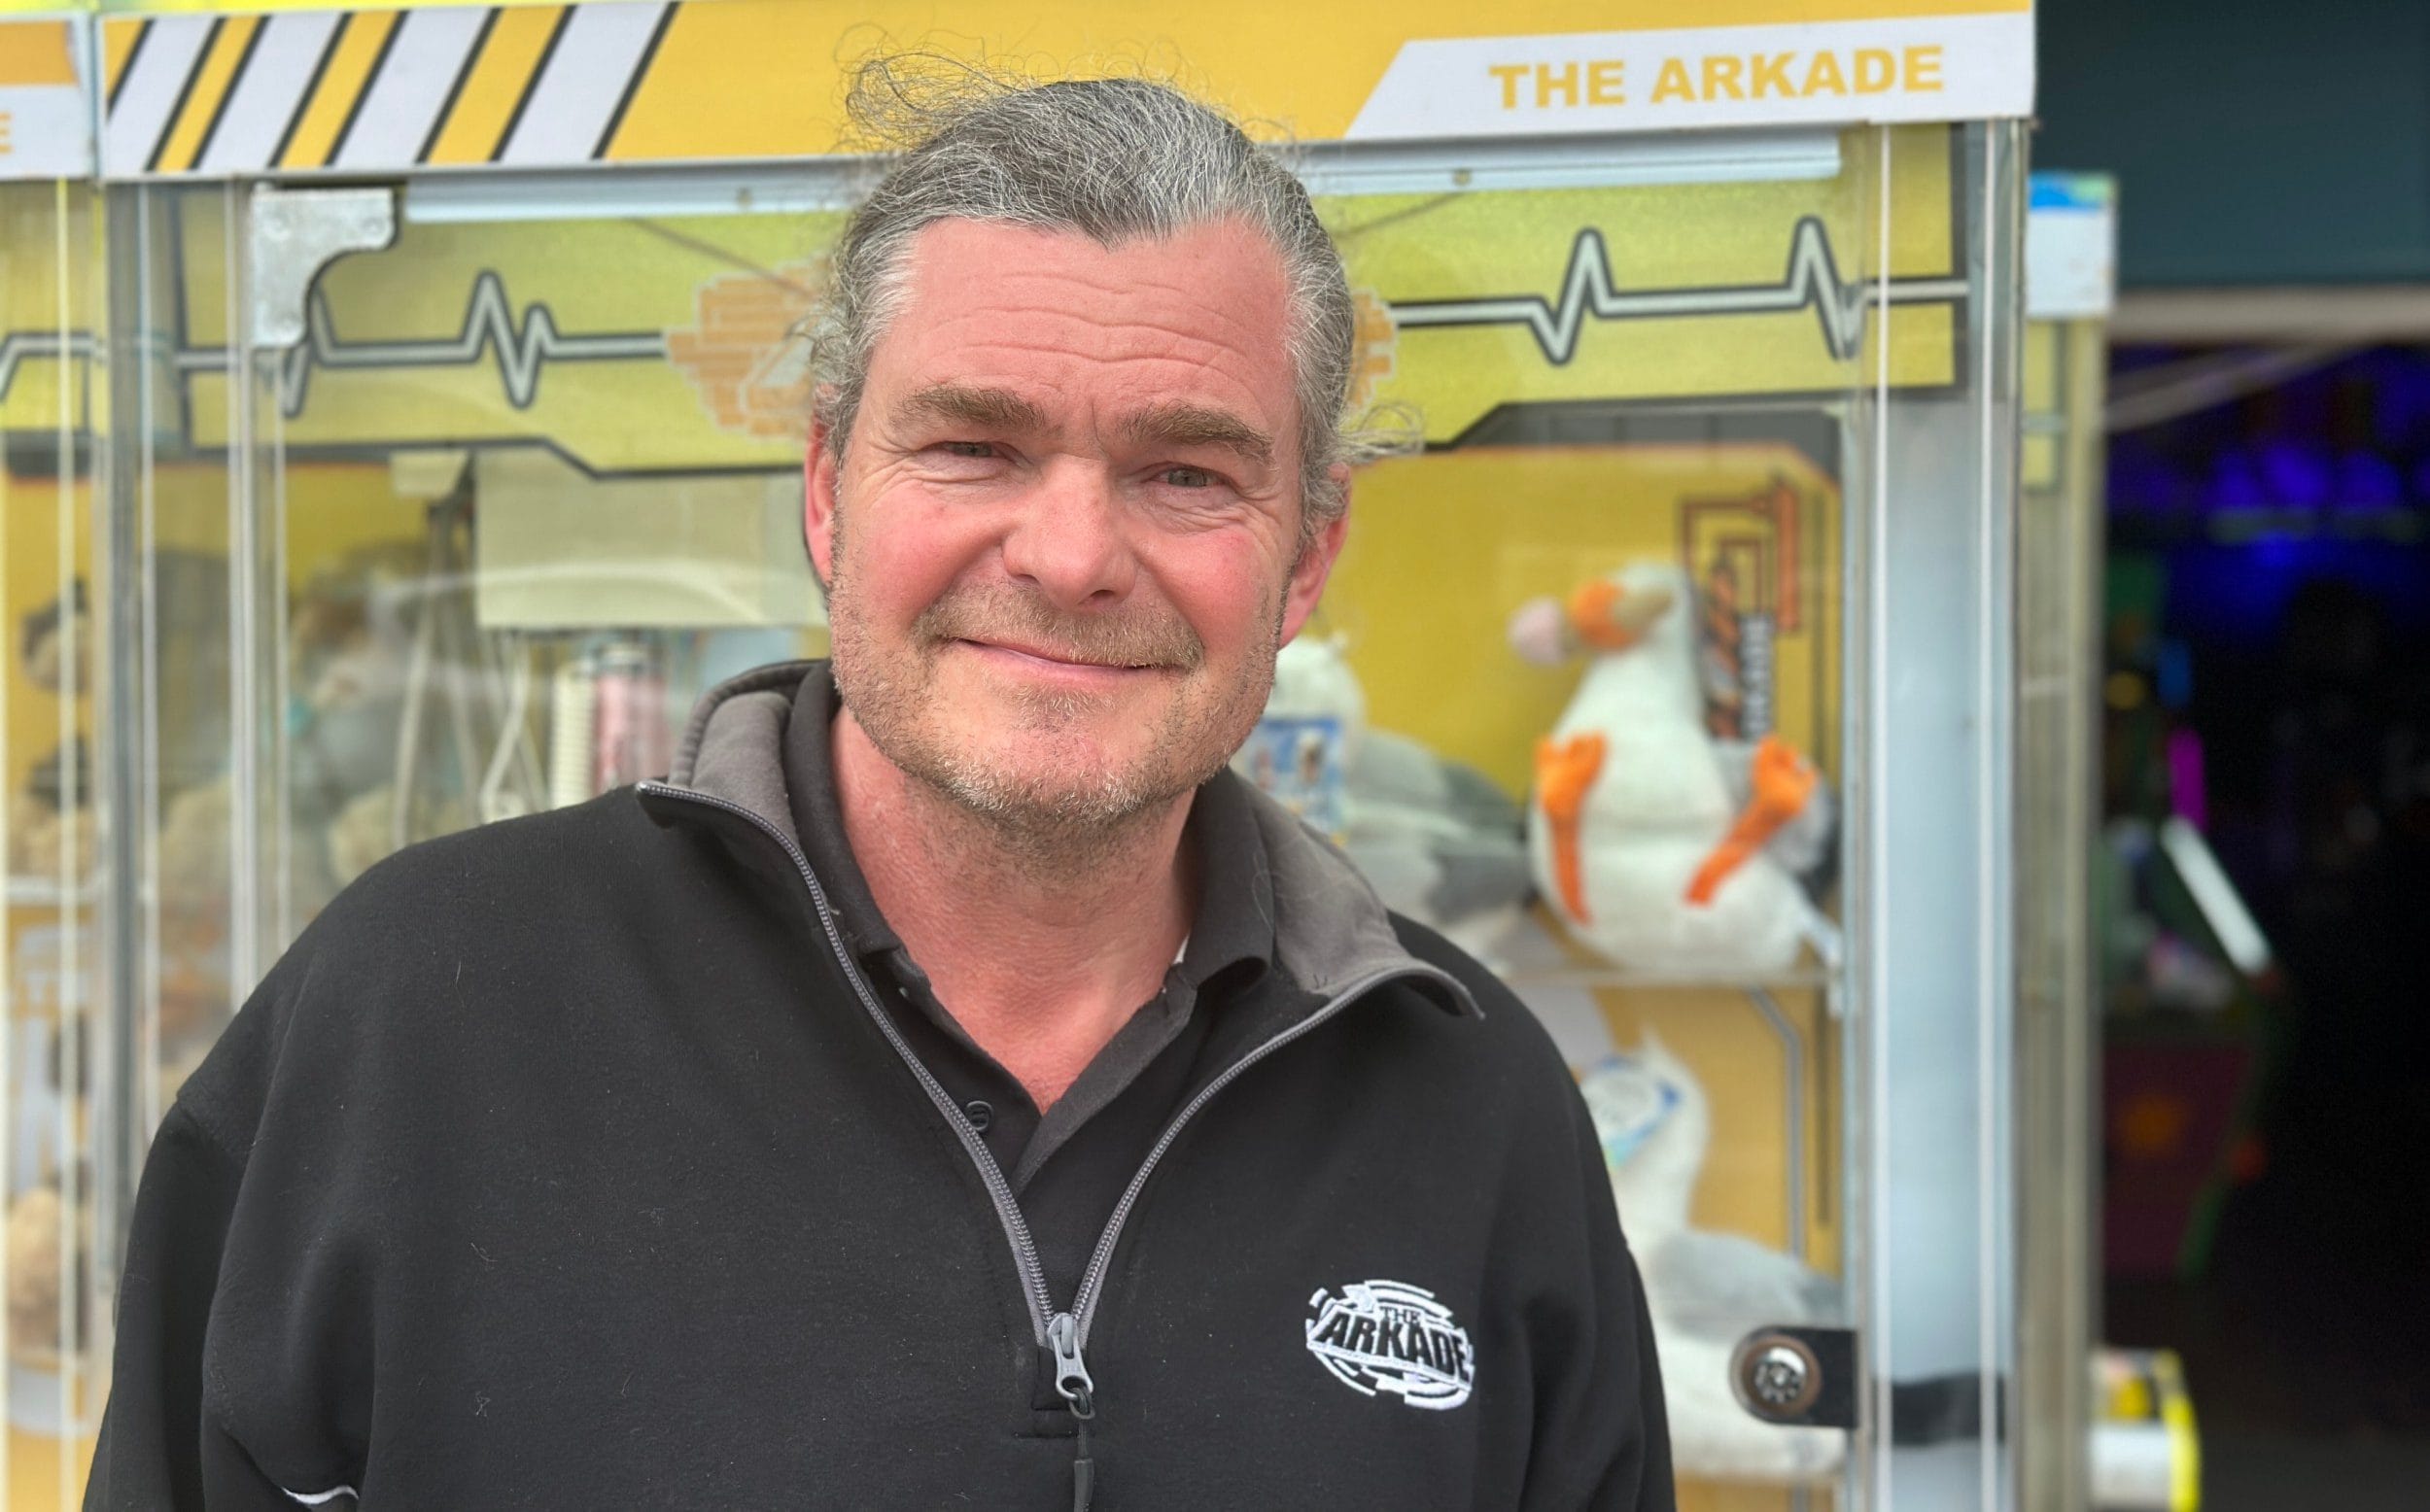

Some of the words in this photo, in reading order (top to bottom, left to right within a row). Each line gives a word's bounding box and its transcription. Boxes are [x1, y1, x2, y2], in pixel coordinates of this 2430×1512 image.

[1489, 61, 1625, 109] THE
[1650, 46, 1944, 103] ARKADE
[1378, 1305, 1421, 1325] THE
[1314, 1312, 1472, 1384] ARKADE
